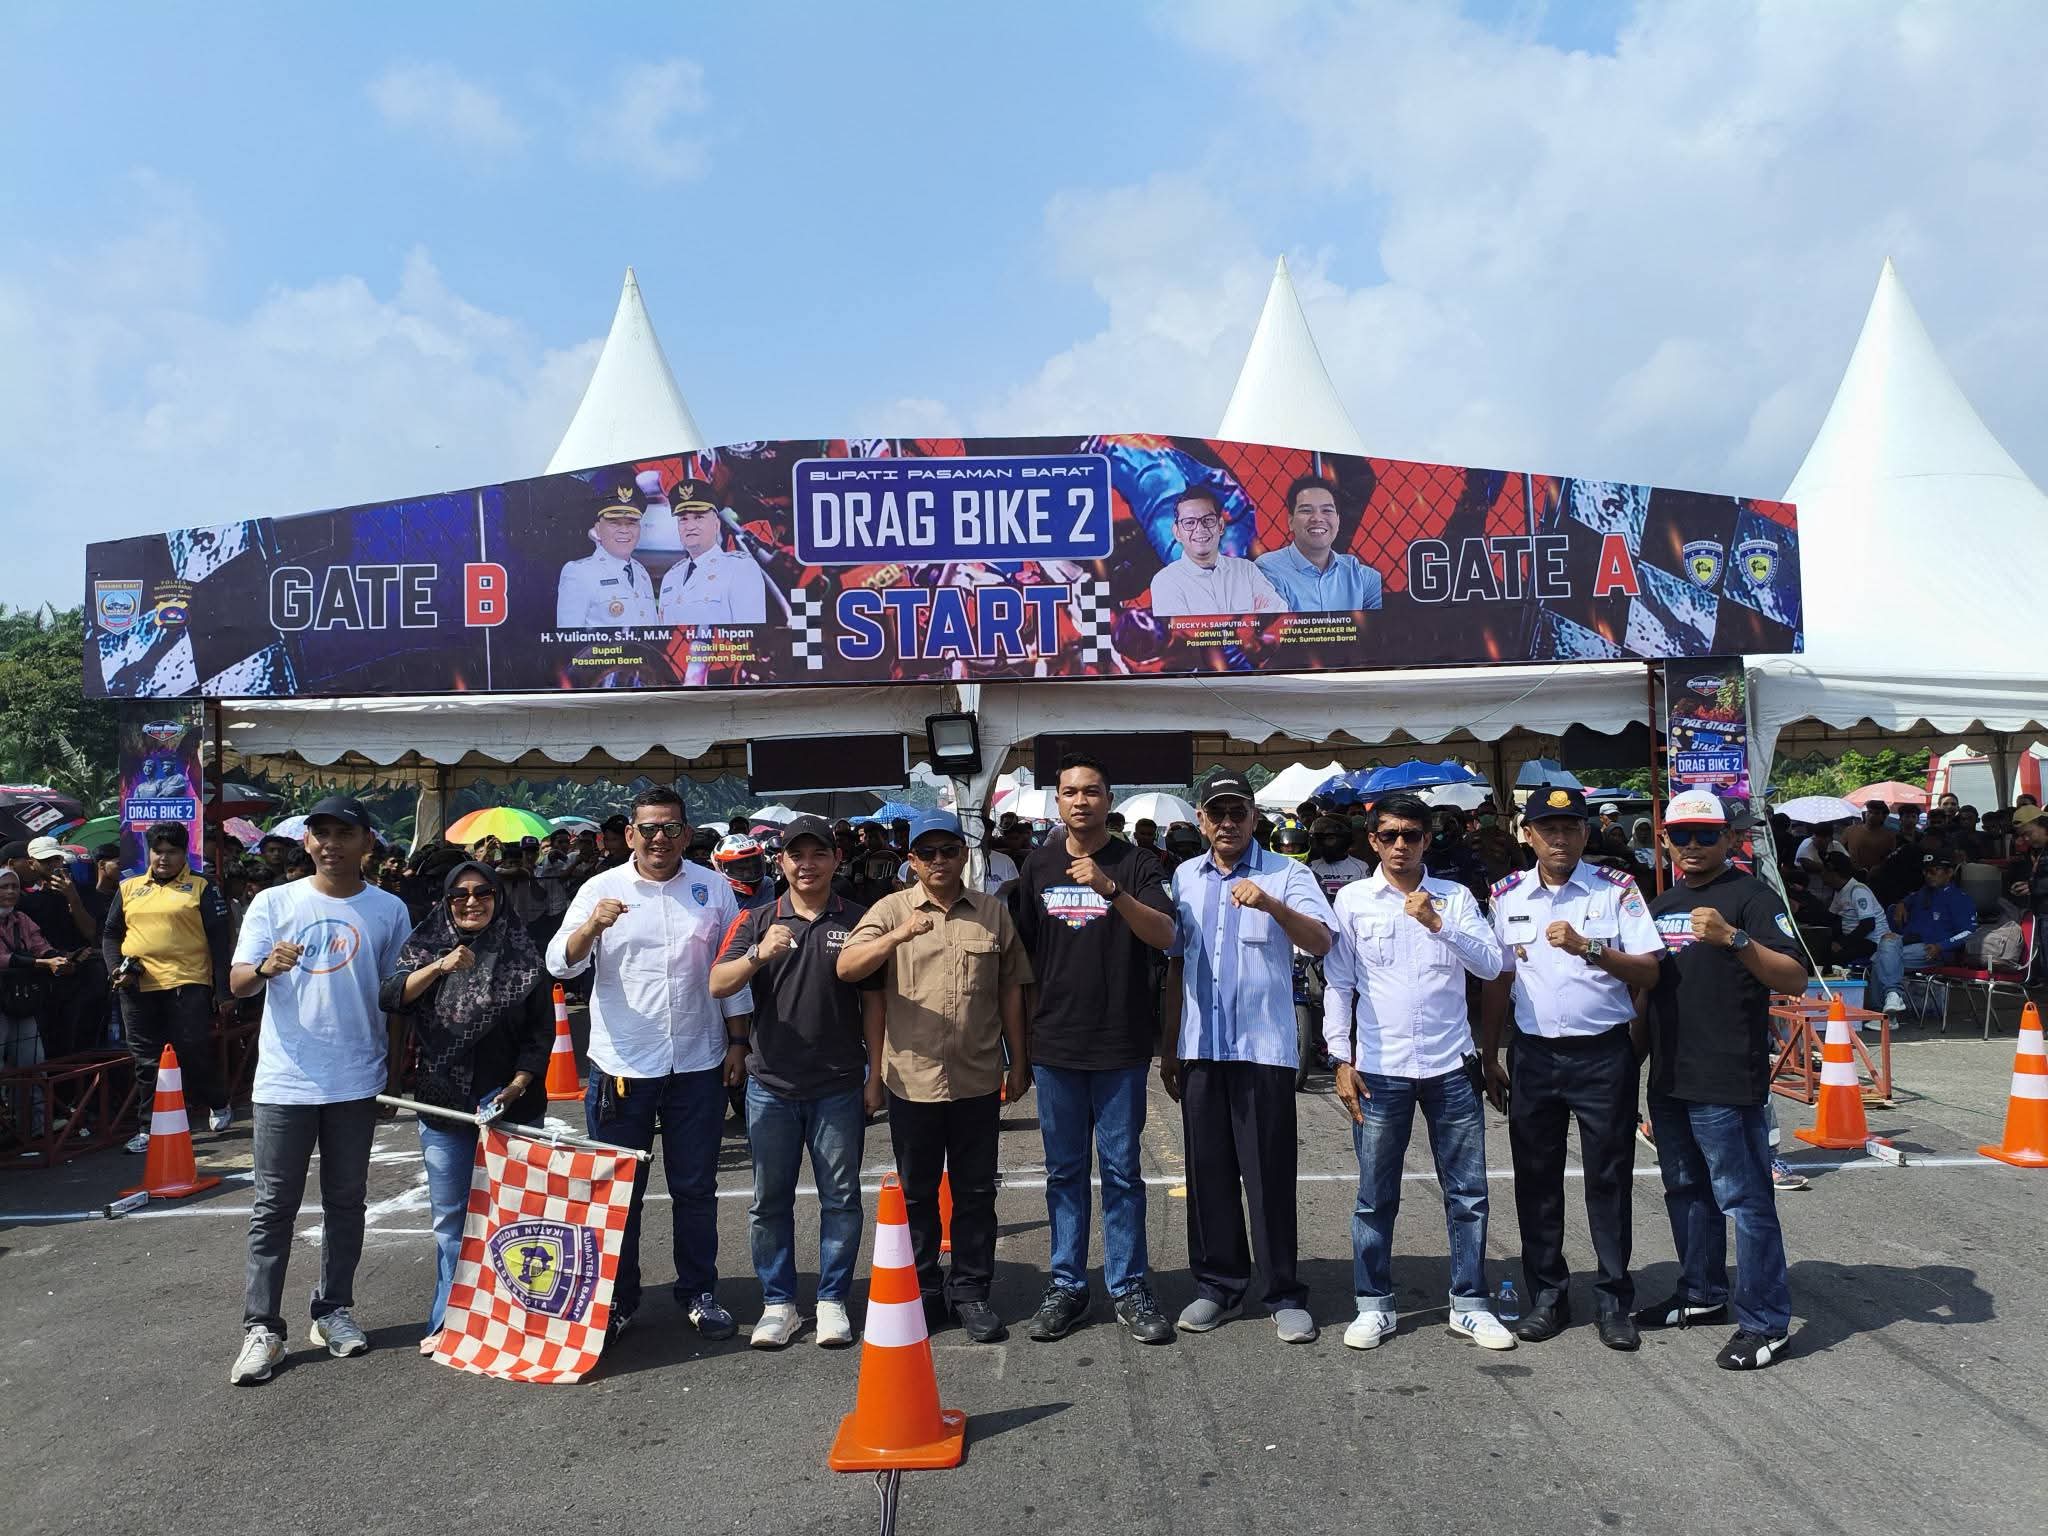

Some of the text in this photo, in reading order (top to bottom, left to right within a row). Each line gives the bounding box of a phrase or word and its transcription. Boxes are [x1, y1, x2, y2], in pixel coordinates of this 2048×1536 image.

[810, 466, 1094, 481] BUPATI PASAMAN BARAT
[812, 487, 1096, 548] DRAG BIKE 2
[1408, 535, 1571, 602] GATE
[1593, 533, 1641, 597] A
[269, 562, 508, 631] GATE B
[836, 584, 1071, 661] START
[1283, 617, 1311, 625] RYANDI
[541, 630, 673, 643] H. Yulianto, S.H., M.M.
[686, 628, 754, 641] H. M. Ihpan
[1279, 627, 1303, 635] KETUA
[1303, 626, 1344, 634] CARETAKER
[691, 642, 749, 653] Wakil Bupati
[1186, 639, 1222, 647] Pasaman
[592, 646, 623, 656] Bupati
[572, 656, 643, 666] Pasaman Barat
[686, 655, 729, 663] Pasaman
[1678, 758, 1740, 772] DRAG BIKE 2
[129, 805, 193, 819] DRAG BIKE 2
[525, 1226, 564, 1238] IKATAN
[583, 1231, 594, 1284] SUMATERA
[573, 1286, 590, 1319] BARAT
